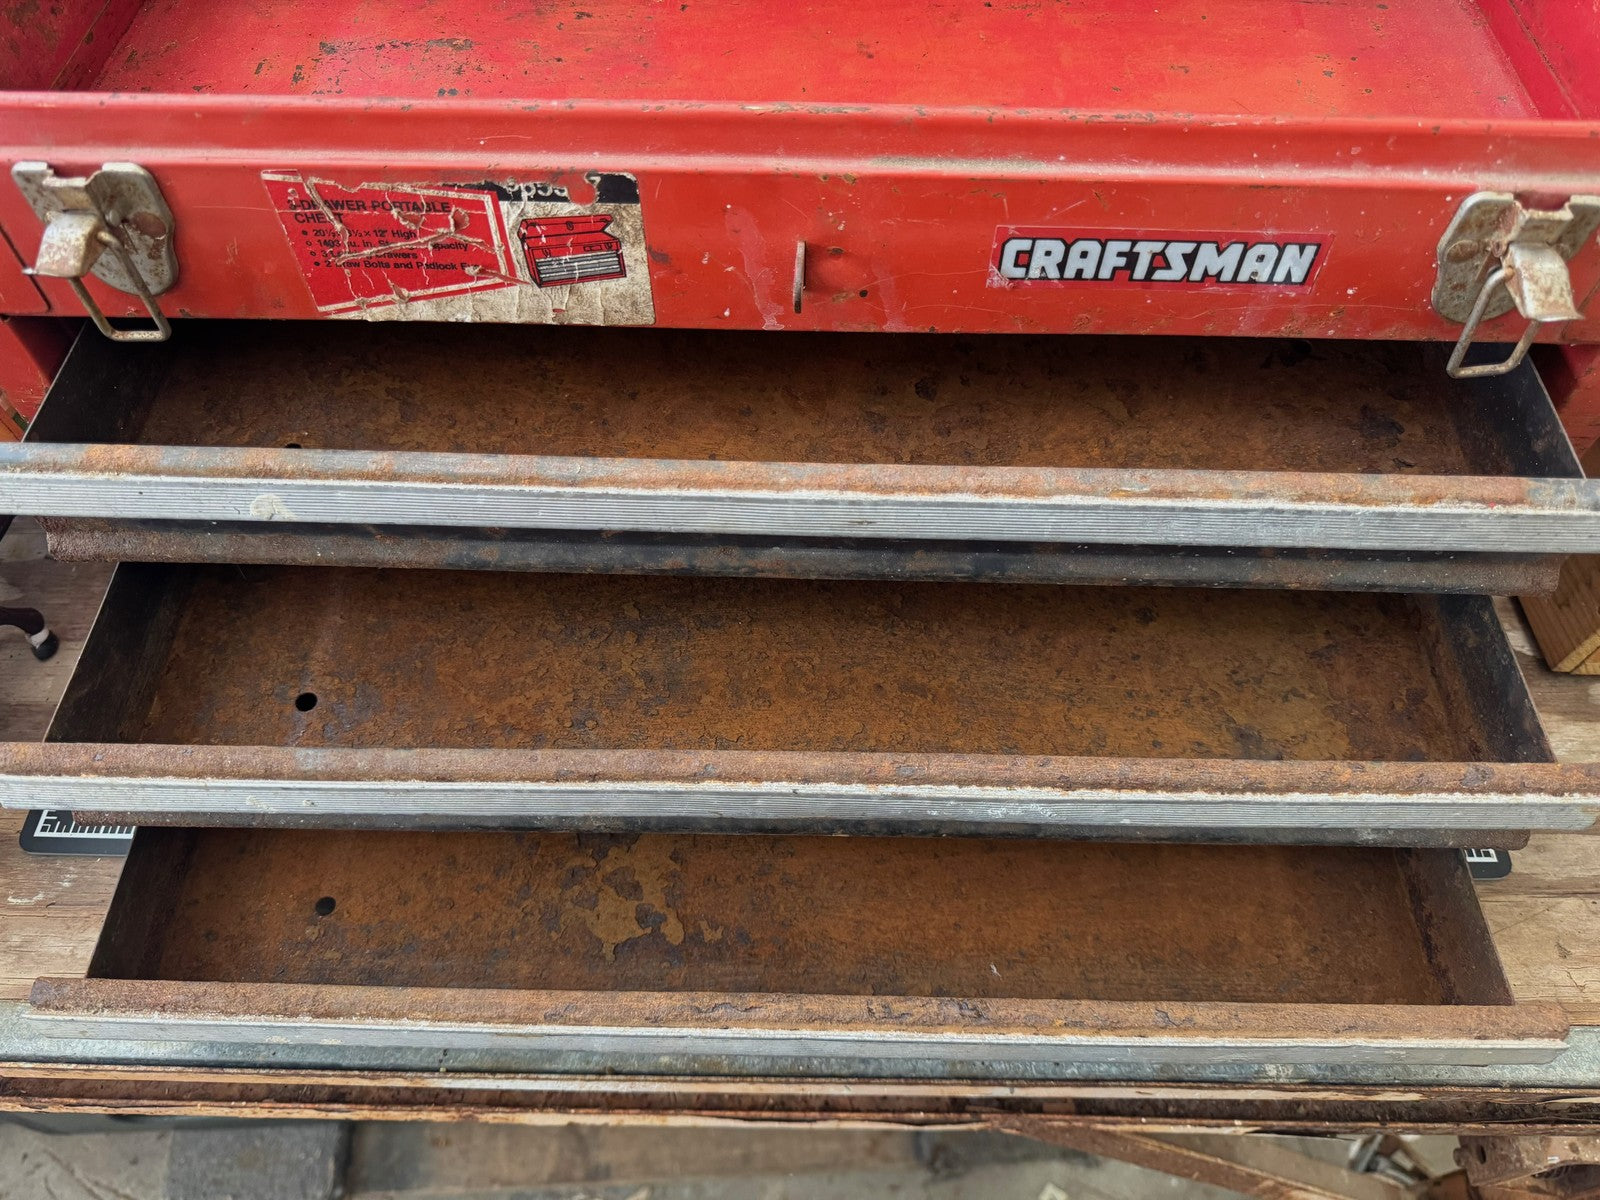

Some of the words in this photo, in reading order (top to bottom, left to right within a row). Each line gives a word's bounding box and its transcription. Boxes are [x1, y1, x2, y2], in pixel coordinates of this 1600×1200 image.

[371, 201, 451, 212] PORTABLE
[294, 212, 343, 223] CHET
[391, 230, 418, 241] High
[431, 242, 468, 251] apacity
[324, 260, 332, 268] 2
[364, 260, 391, 269] Bolts
[393, 261, 413, 269] and
[999, 237, 1319, 285] CRAFTSMAN
